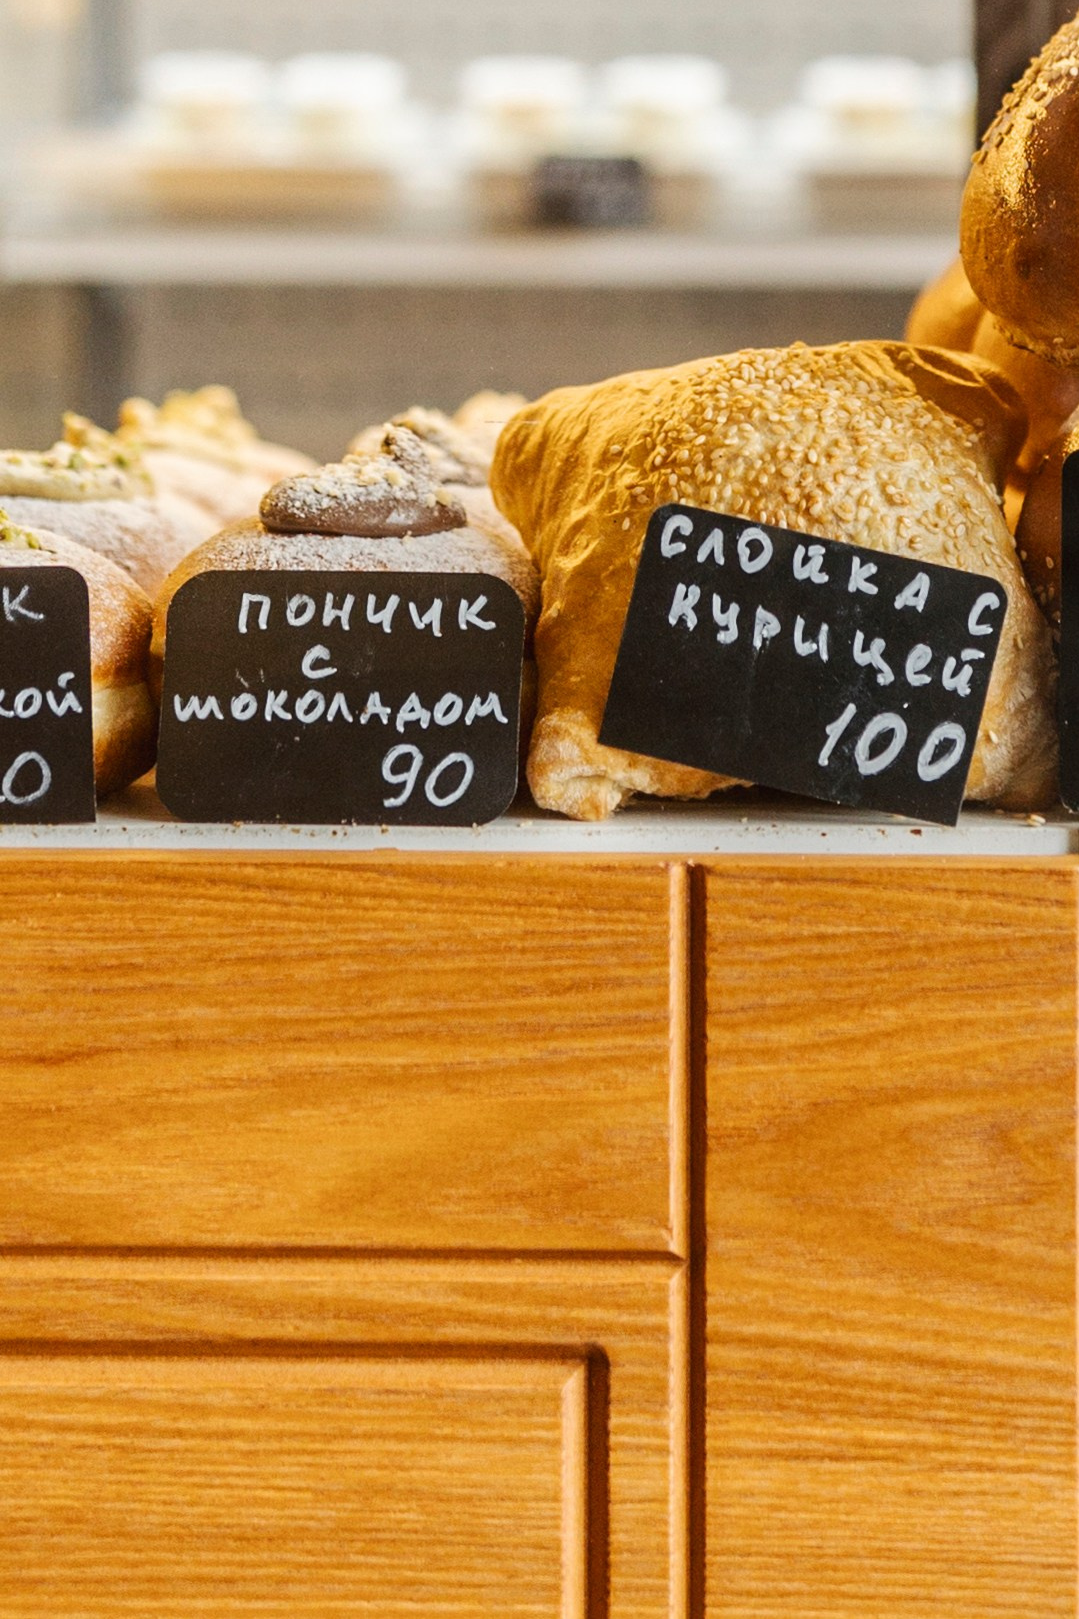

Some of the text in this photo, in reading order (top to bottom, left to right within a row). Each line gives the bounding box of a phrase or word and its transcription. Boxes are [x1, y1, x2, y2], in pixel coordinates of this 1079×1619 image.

[818, 703, 967, 782] 100
[0, 751, 52, 806] 0
[381, 744, 475, 809] 90
